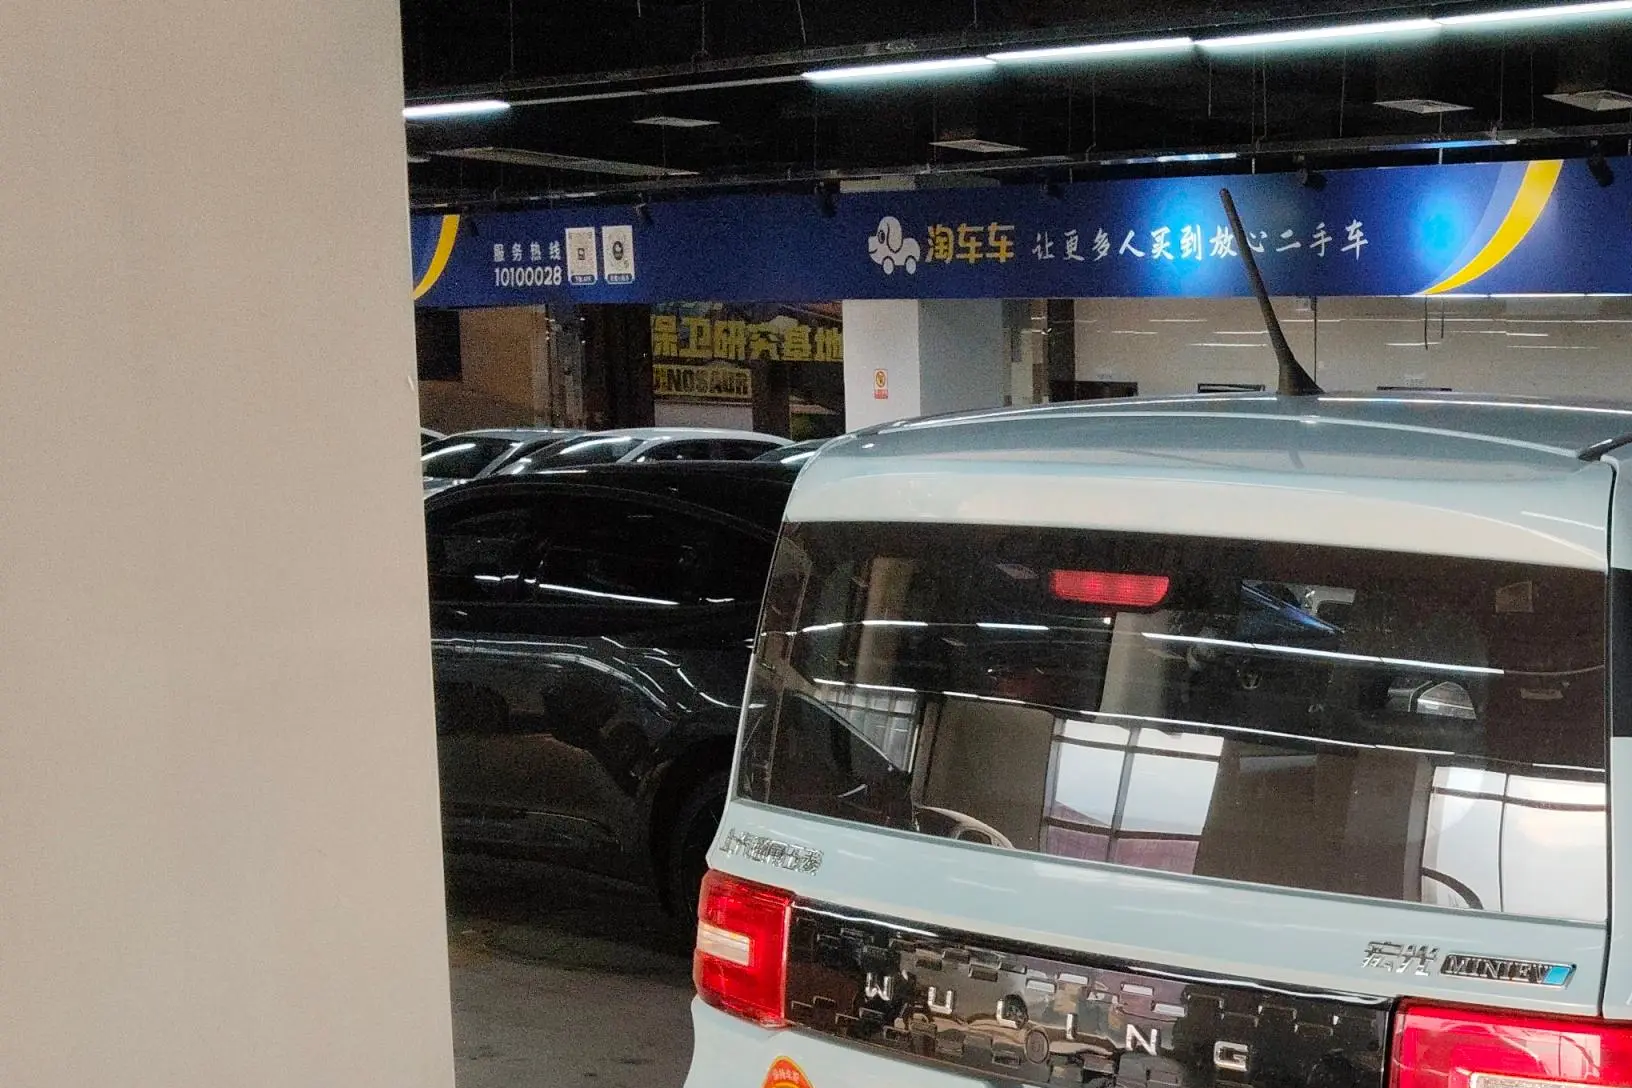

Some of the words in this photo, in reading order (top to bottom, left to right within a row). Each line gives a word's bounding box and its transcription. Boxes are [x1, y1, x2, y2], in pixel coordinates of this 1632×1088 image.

[493, 240, 562, 263] 服务热线
[924, 221, 1016, 264] 淘车车
[1032, 219, 1370, 263] 让更多人买到放心二手车
[494, 265, 562, 287] 10100028
[865, 971, 1249, 1073] WULING
